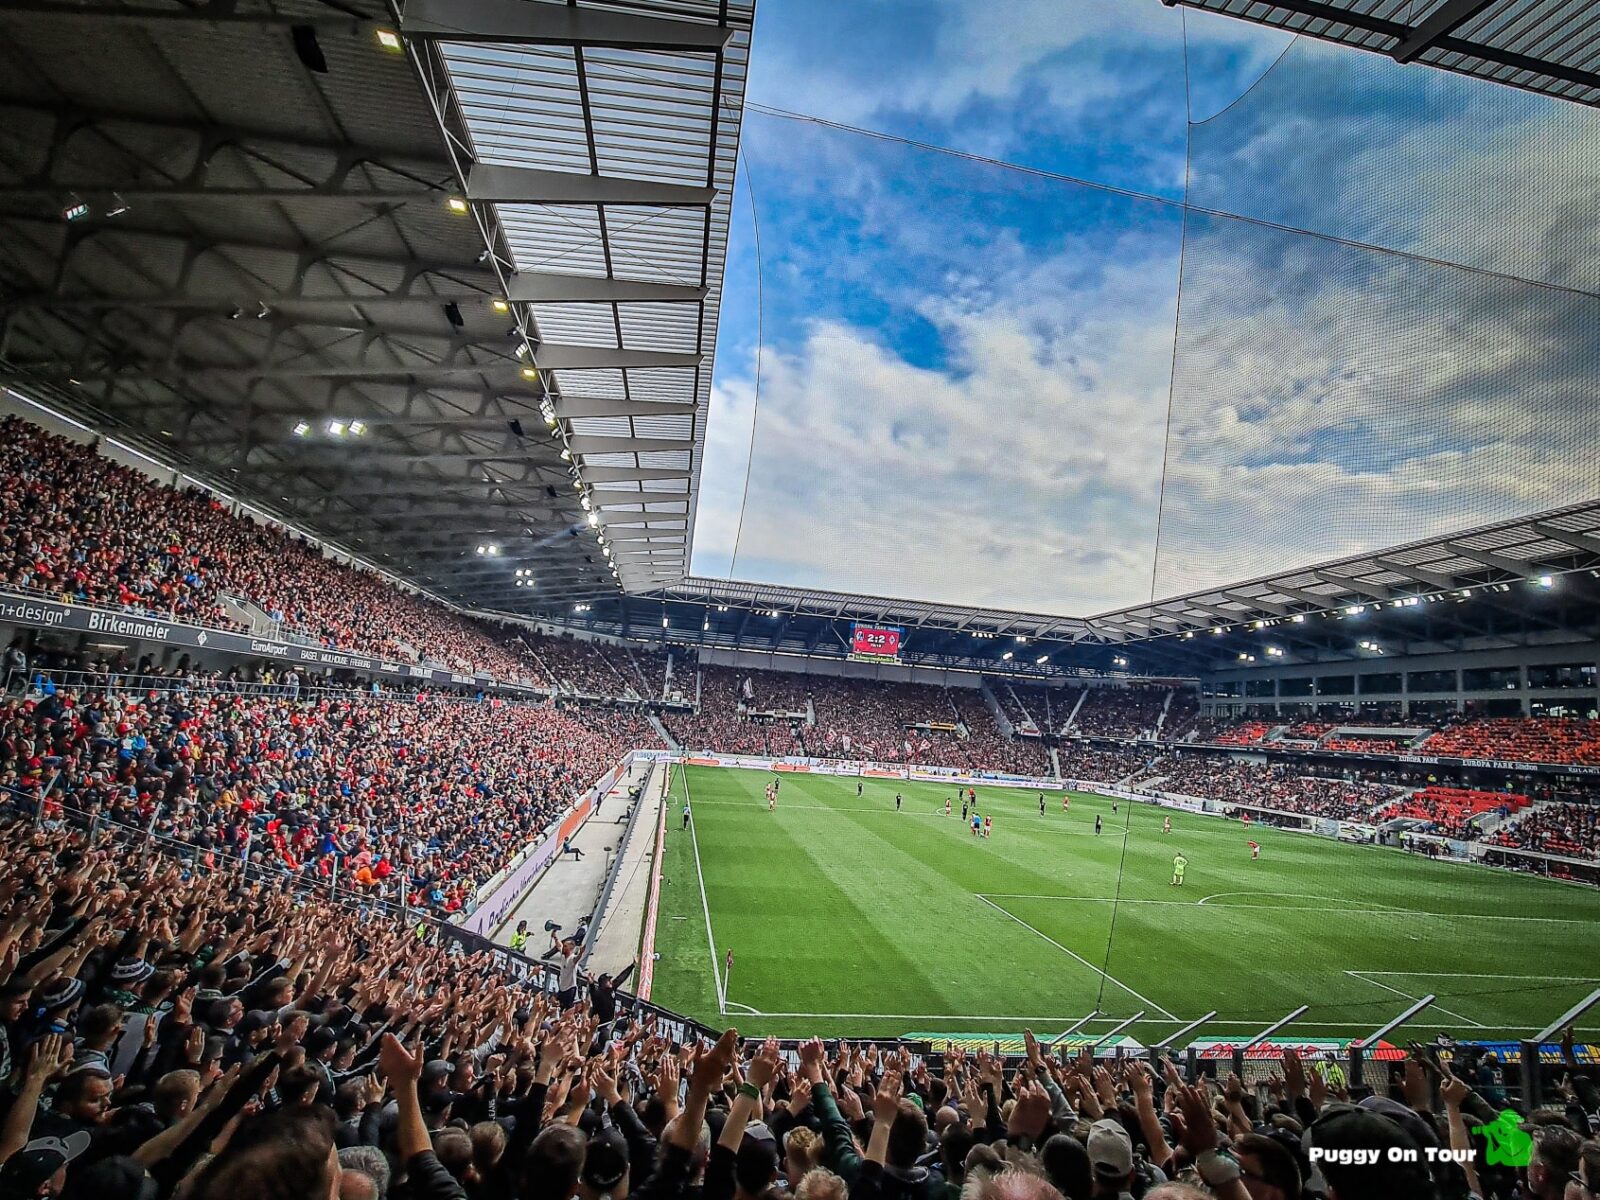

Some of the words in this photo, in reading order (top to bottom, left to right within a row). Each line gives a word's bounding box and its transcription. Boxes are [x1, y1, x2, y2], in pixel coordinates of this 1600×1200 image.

[88, 612, 170, 640] Birkenmeier
[867, 633, 885, 644] 2:2
[251, 640, 289, 657] EuroAirport
[1462, 759, 1490, 769] EUROPA
[1493, 761, 1514, 770] PARK
